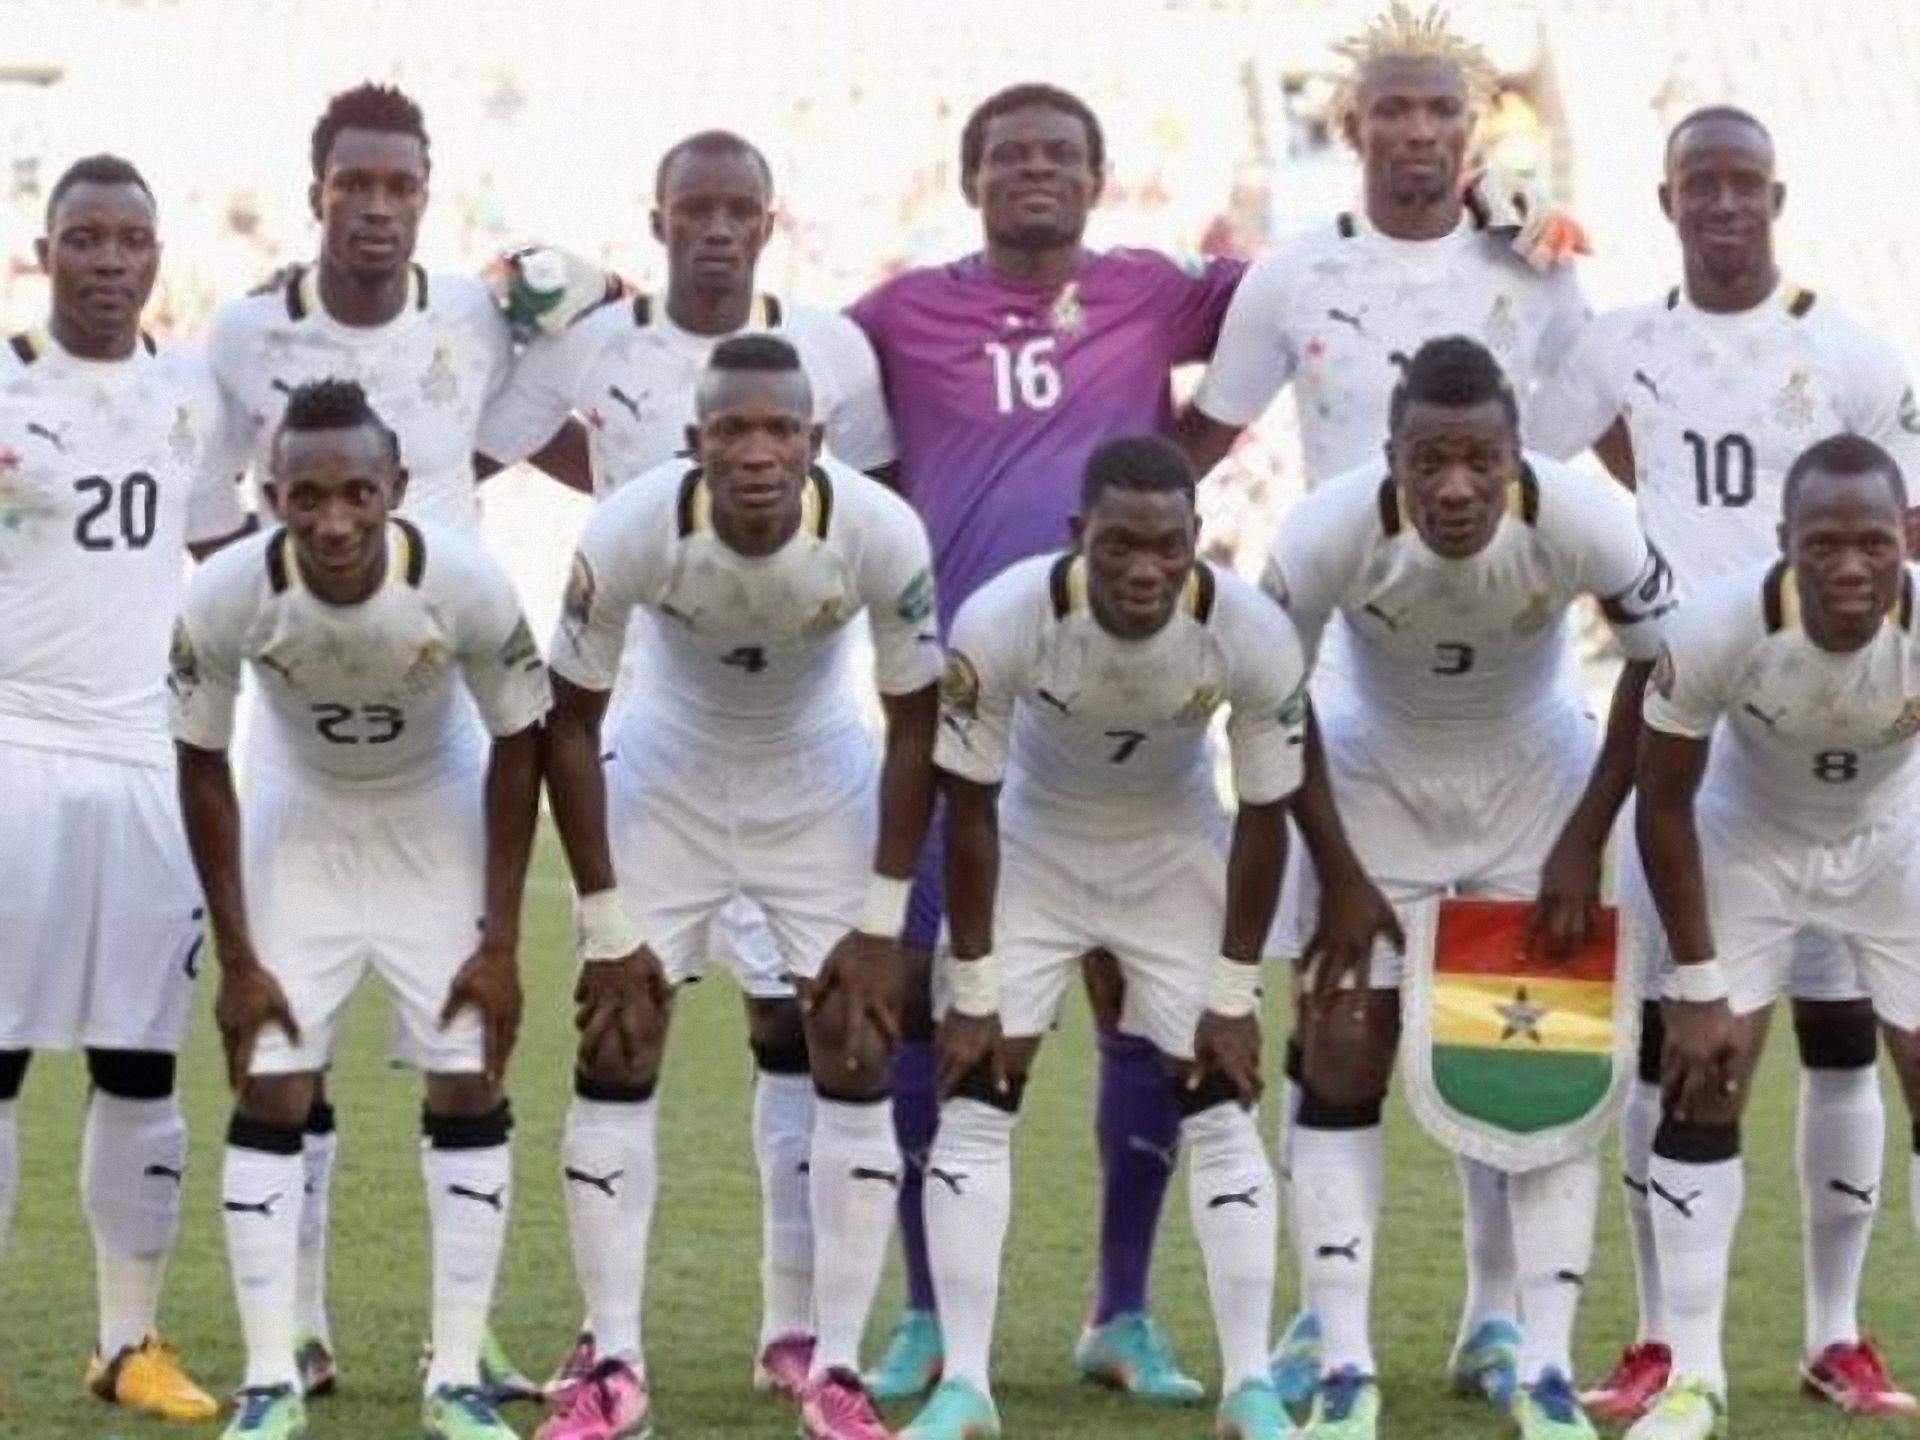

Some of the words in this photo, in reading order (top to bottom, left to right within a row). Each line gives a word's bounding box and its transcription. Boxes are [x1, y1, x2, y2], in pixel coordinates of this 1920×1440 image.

[986, 338, 1062, 414] 16
[1682, 428, 1757, 508] 10
[73, 471, 158, 552] 20
[719, 644, 769, 675] 4
[1431, 642, 1477, 677] 3
[310, 701, 407, 746] 23
[1104, 729, 1148, 765] 7
[1811, 749, 1861, 784] 8
